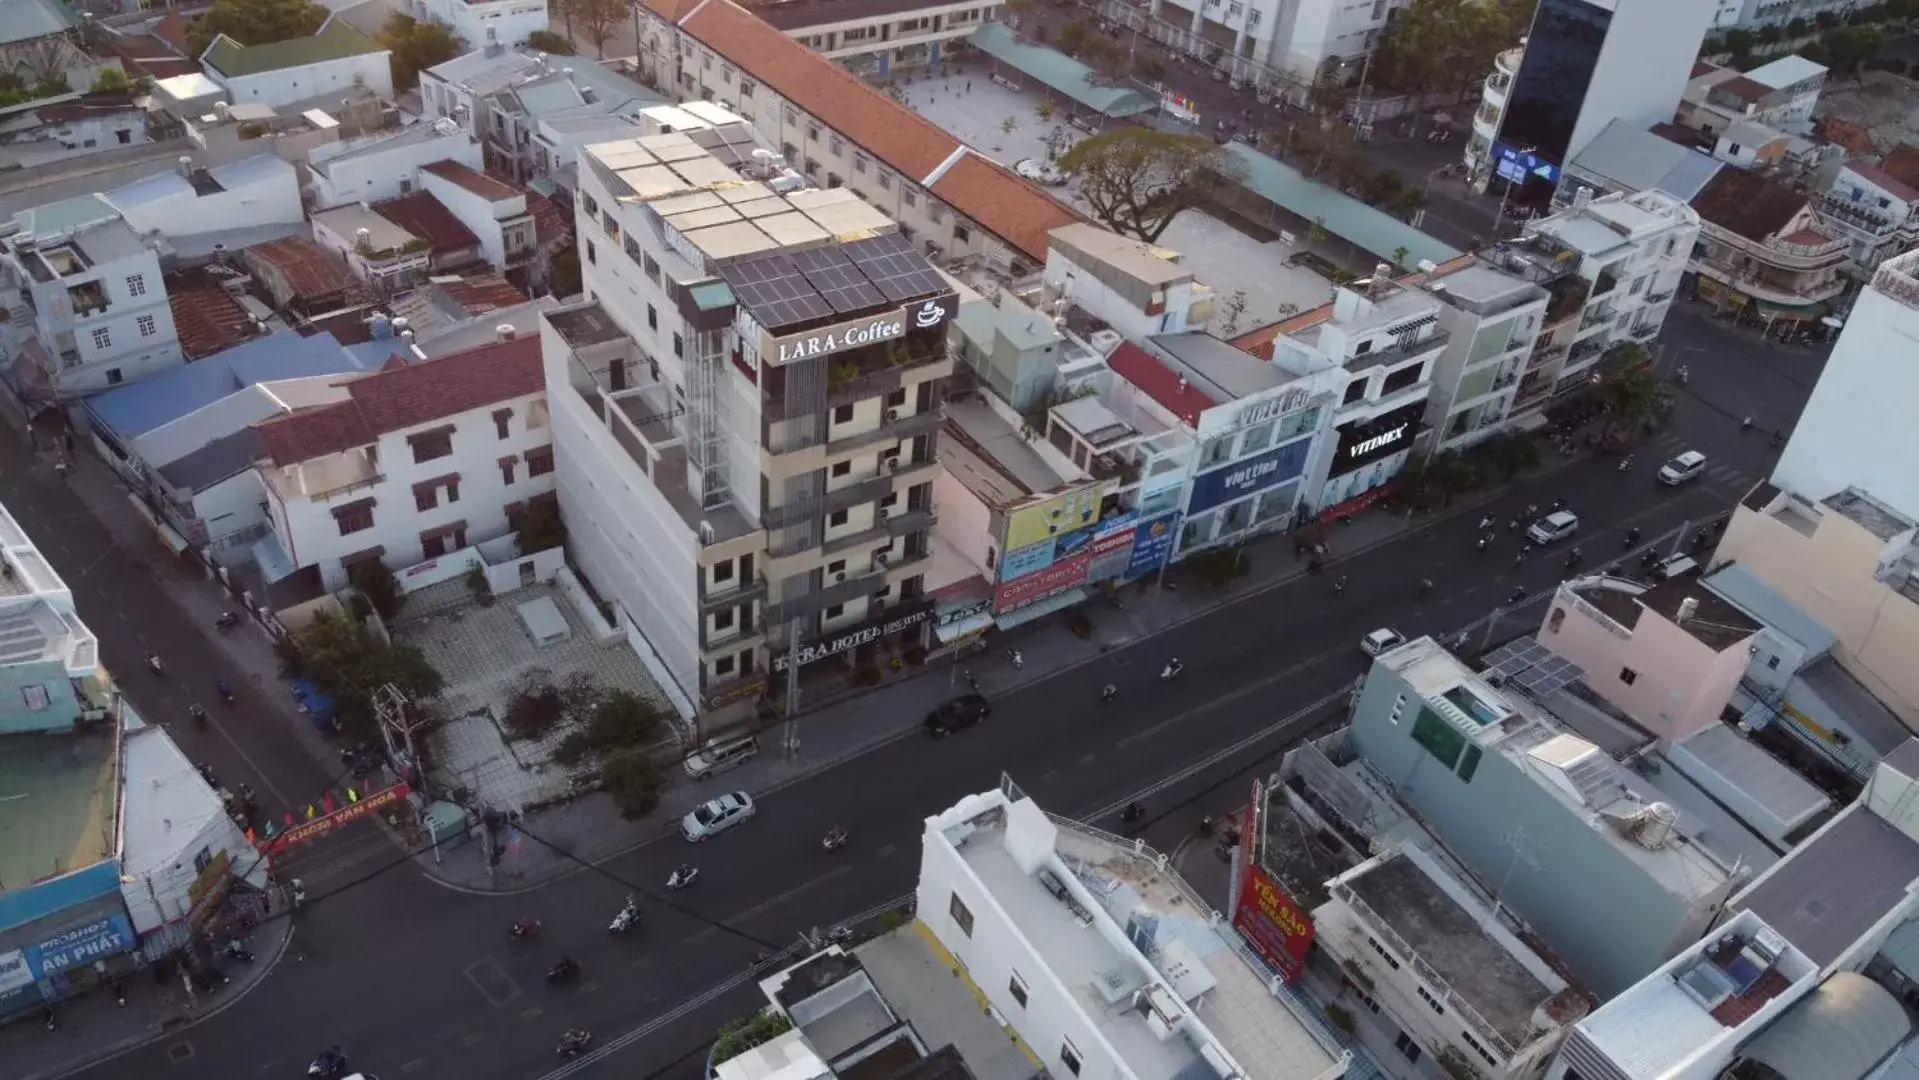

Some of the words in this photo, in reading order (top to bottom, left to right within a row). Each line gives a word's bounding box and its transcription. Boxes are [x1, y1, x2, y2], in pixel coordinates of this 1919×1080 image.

[779, 320, 900, 362] LARA-Coffee
[1350, 426, 1404, 458] VITIMEX
[831, 625, 882, 651] HOTEL
[42, 952, 70, 973] AN
